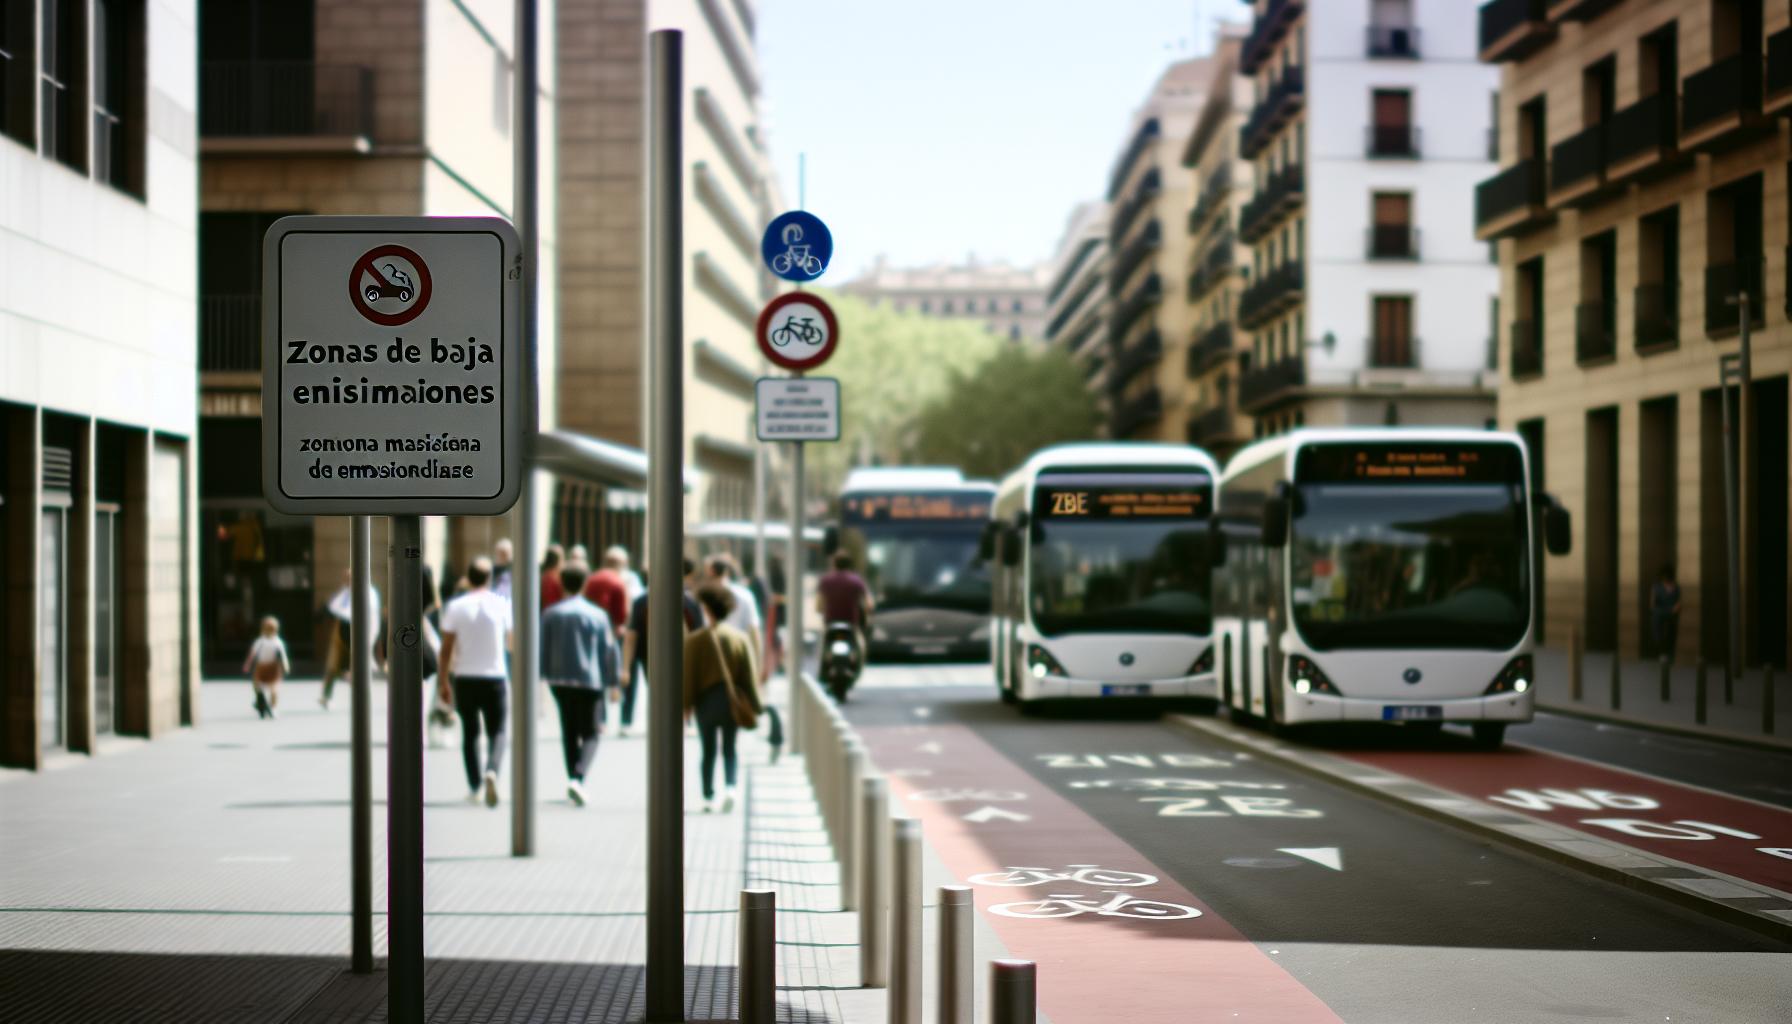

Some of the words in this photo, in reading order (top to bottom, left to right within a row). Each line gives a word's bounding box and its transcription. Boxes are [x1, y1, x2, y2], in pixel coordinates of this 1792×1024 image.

[286, 340, 378, 364] Zonas
[386, 336, 421, 363] de
[430, 336, 495, 371] baja
[292, 376, 495, 405] enisimaiones
